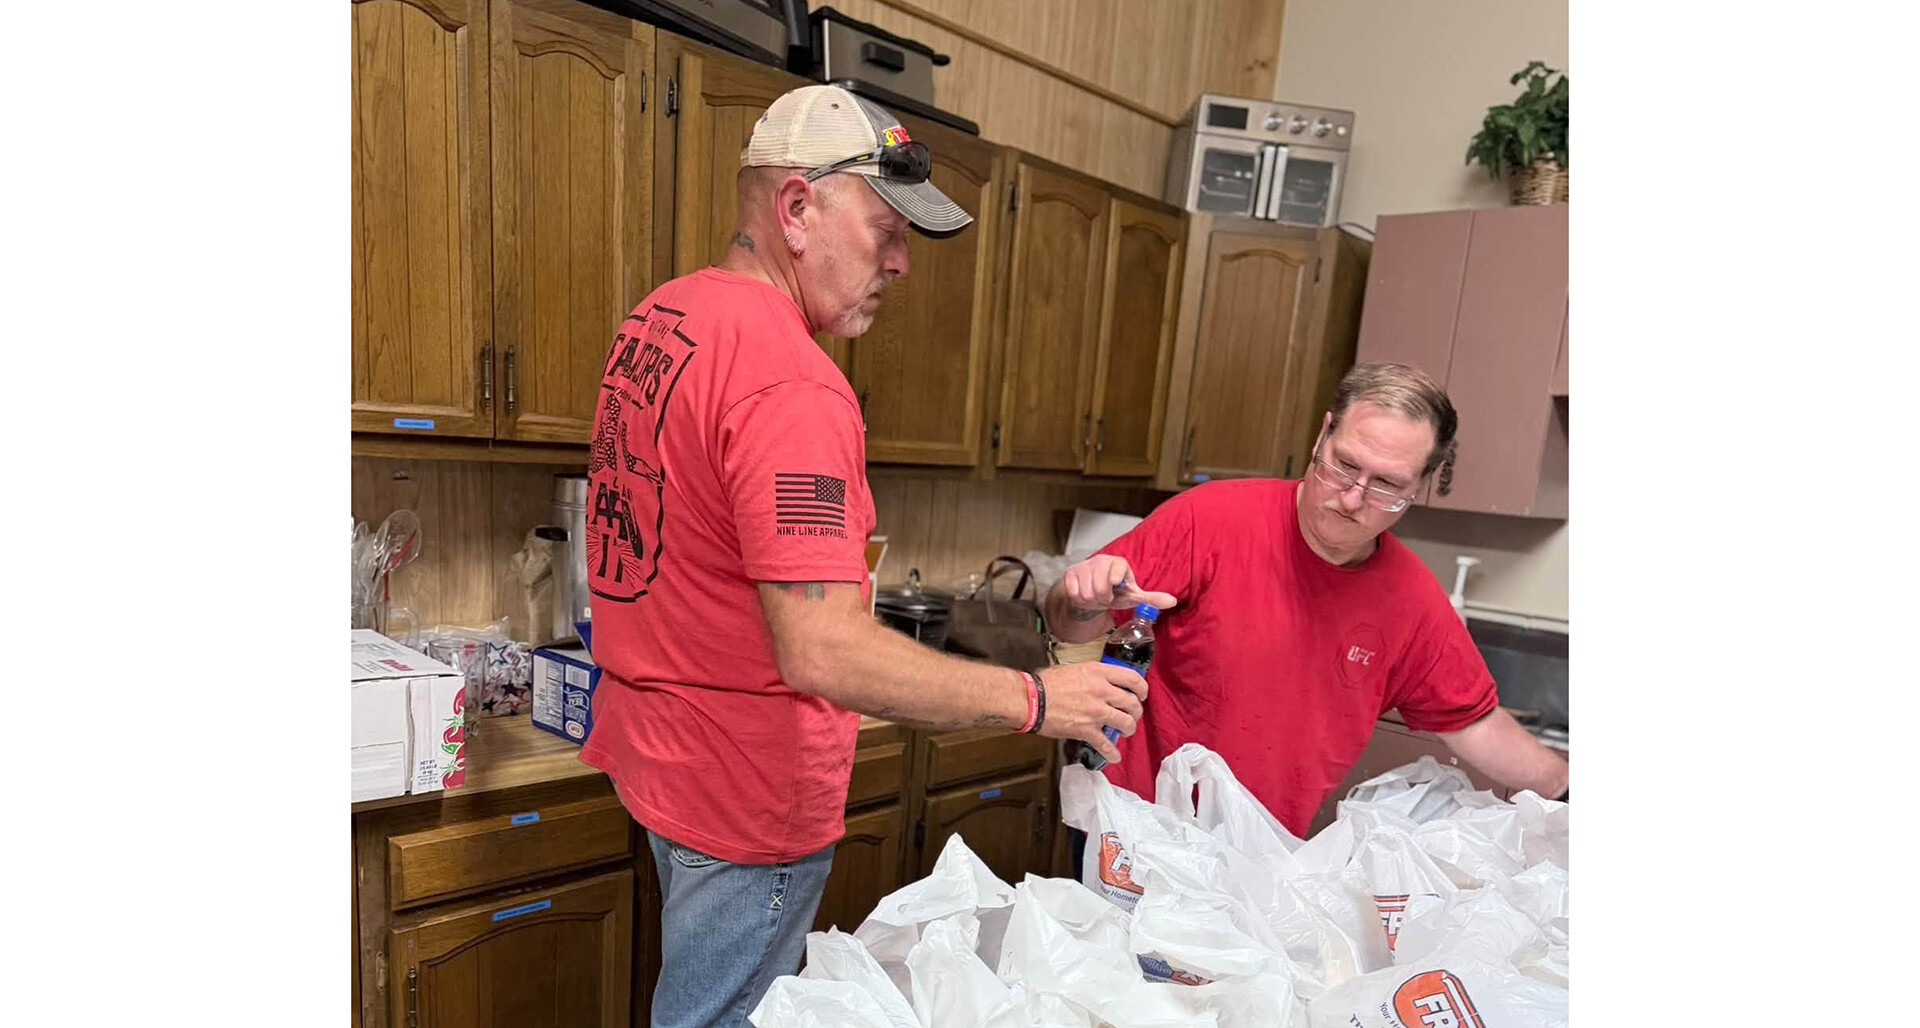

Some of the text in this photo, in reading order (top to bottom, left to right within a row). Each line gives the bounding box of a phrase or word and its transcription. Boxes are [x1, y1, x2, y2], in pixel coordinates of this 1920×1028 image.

[776, 526, 849, 540] NINE LINE APPAREL
[1347, 645, 1376, 666] UFC
